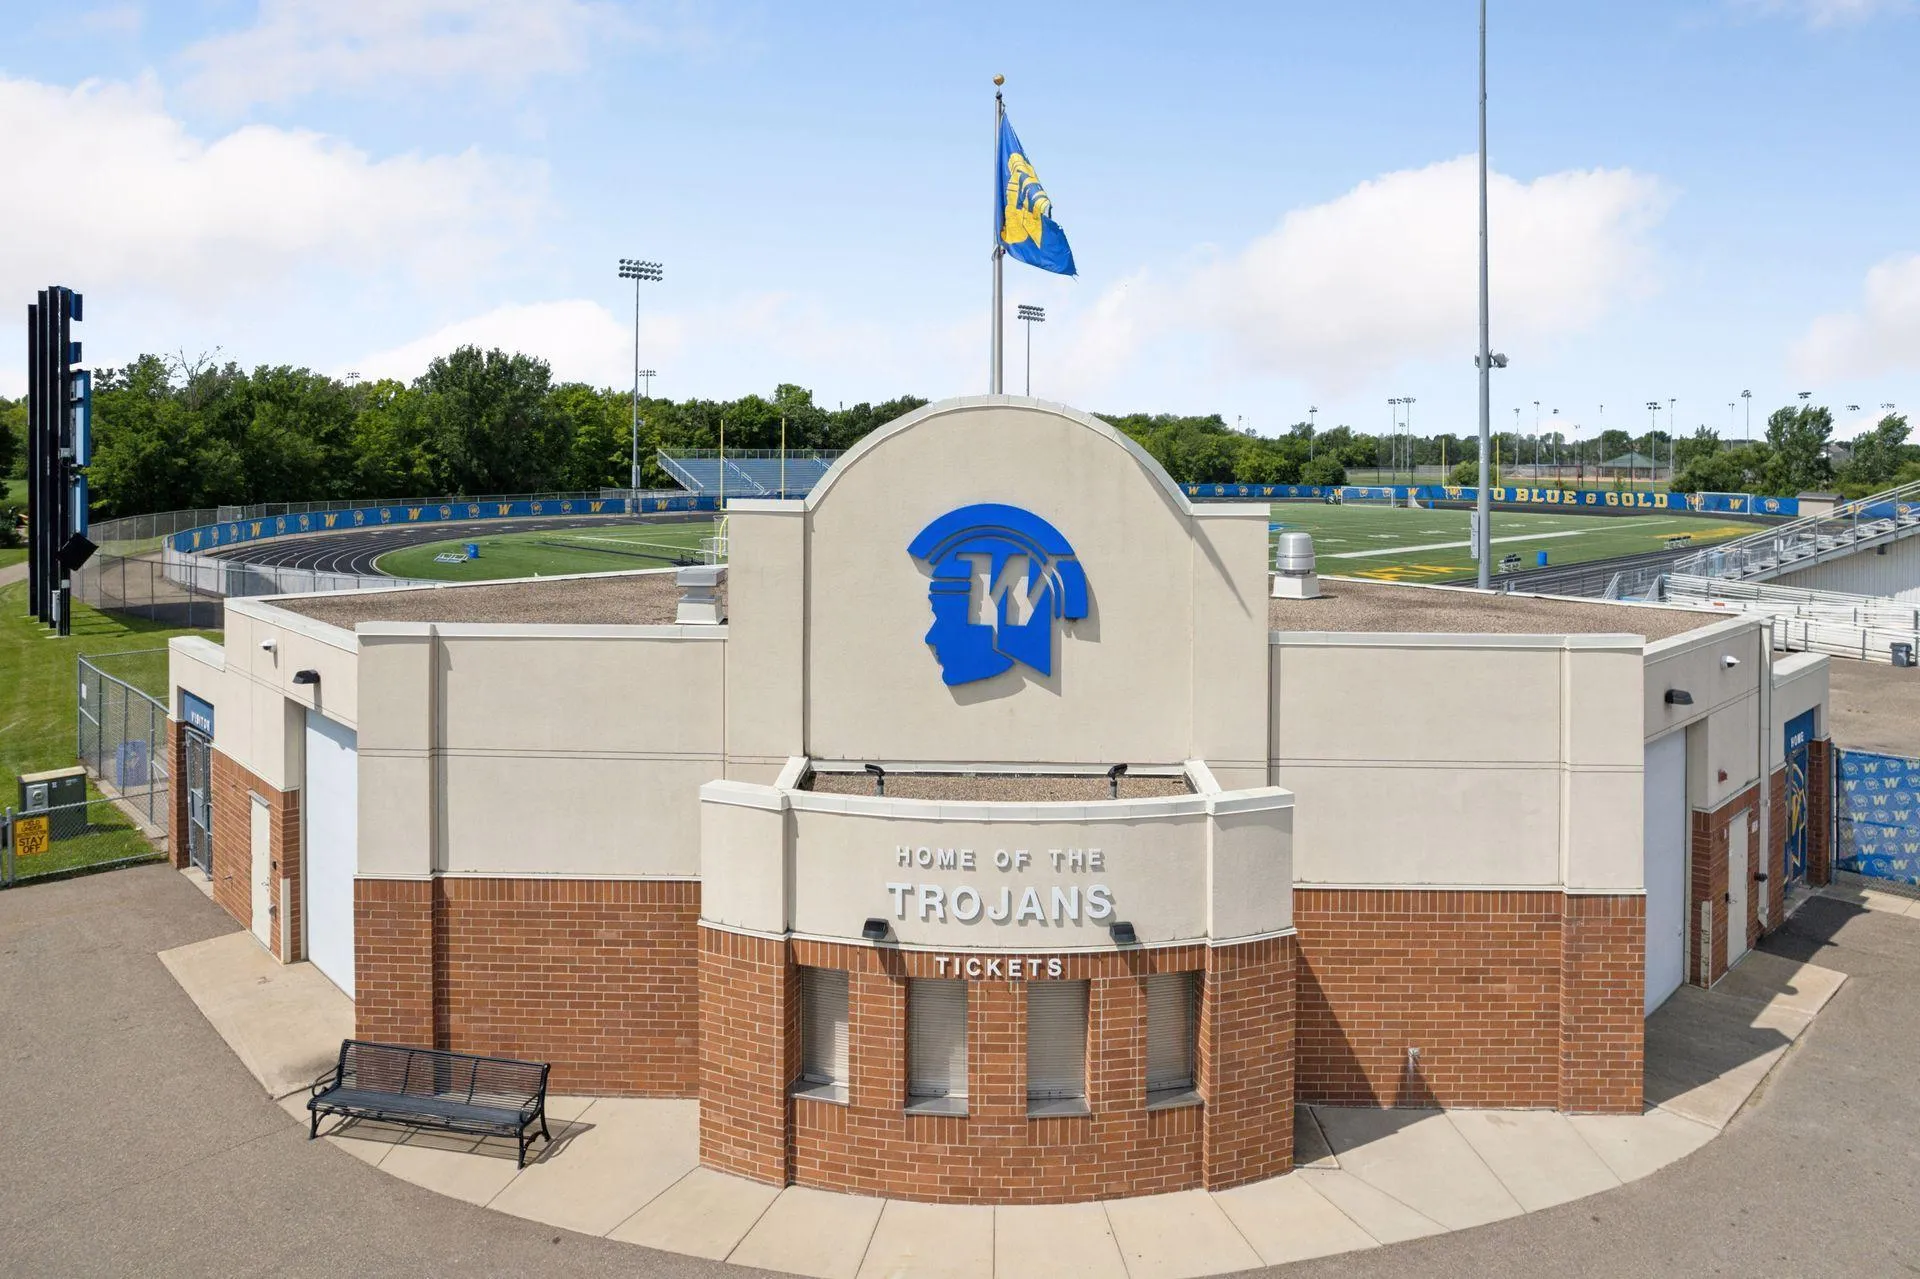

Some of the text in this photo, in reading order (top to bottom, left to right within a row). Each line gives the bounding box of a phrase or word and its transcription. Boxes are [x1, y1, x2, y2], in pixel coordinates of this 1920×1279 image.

[1187, 486, 1200, 495] W
[1262, 486, 1275, 495] W
[1493, 487, 1505, 501] O
[1515, 488, 1577, 504] BLUE
[1605, 491, 1668, 508] GOLD
[1729, 498, 1744, 509] W
[496, 503, 513, 515] W
[589, 501, 606, 513] W
[655, 499, 670, 511] W
[408, 507, 423, 520] W
[324, 513, 338, 528] W
[251, 521, 263, 537] W
[193, 531, 202, 549] W
[1862, 762, 1880, 773] W
[1882, 777, 1901, 789] W
[1870, 794, 1890, 806] W
[1851, 812, 1869, 824] W
[1892, 809, 1911, 821] W
[1881, 827, 1898, 838] W
[18, 835, 45, 847] STAY
[23, 844, 41, 854] OFF
[1861, 844, 1878, 855] W
[1902, 843, 1919, 854] W
[896, 845, 1102, 868] HOME OF THE
[1890, 859, 1908, 870] W
[886, 881, 1113, 921] TROJANS
[935, 956, 1063, 977] TICKETS
